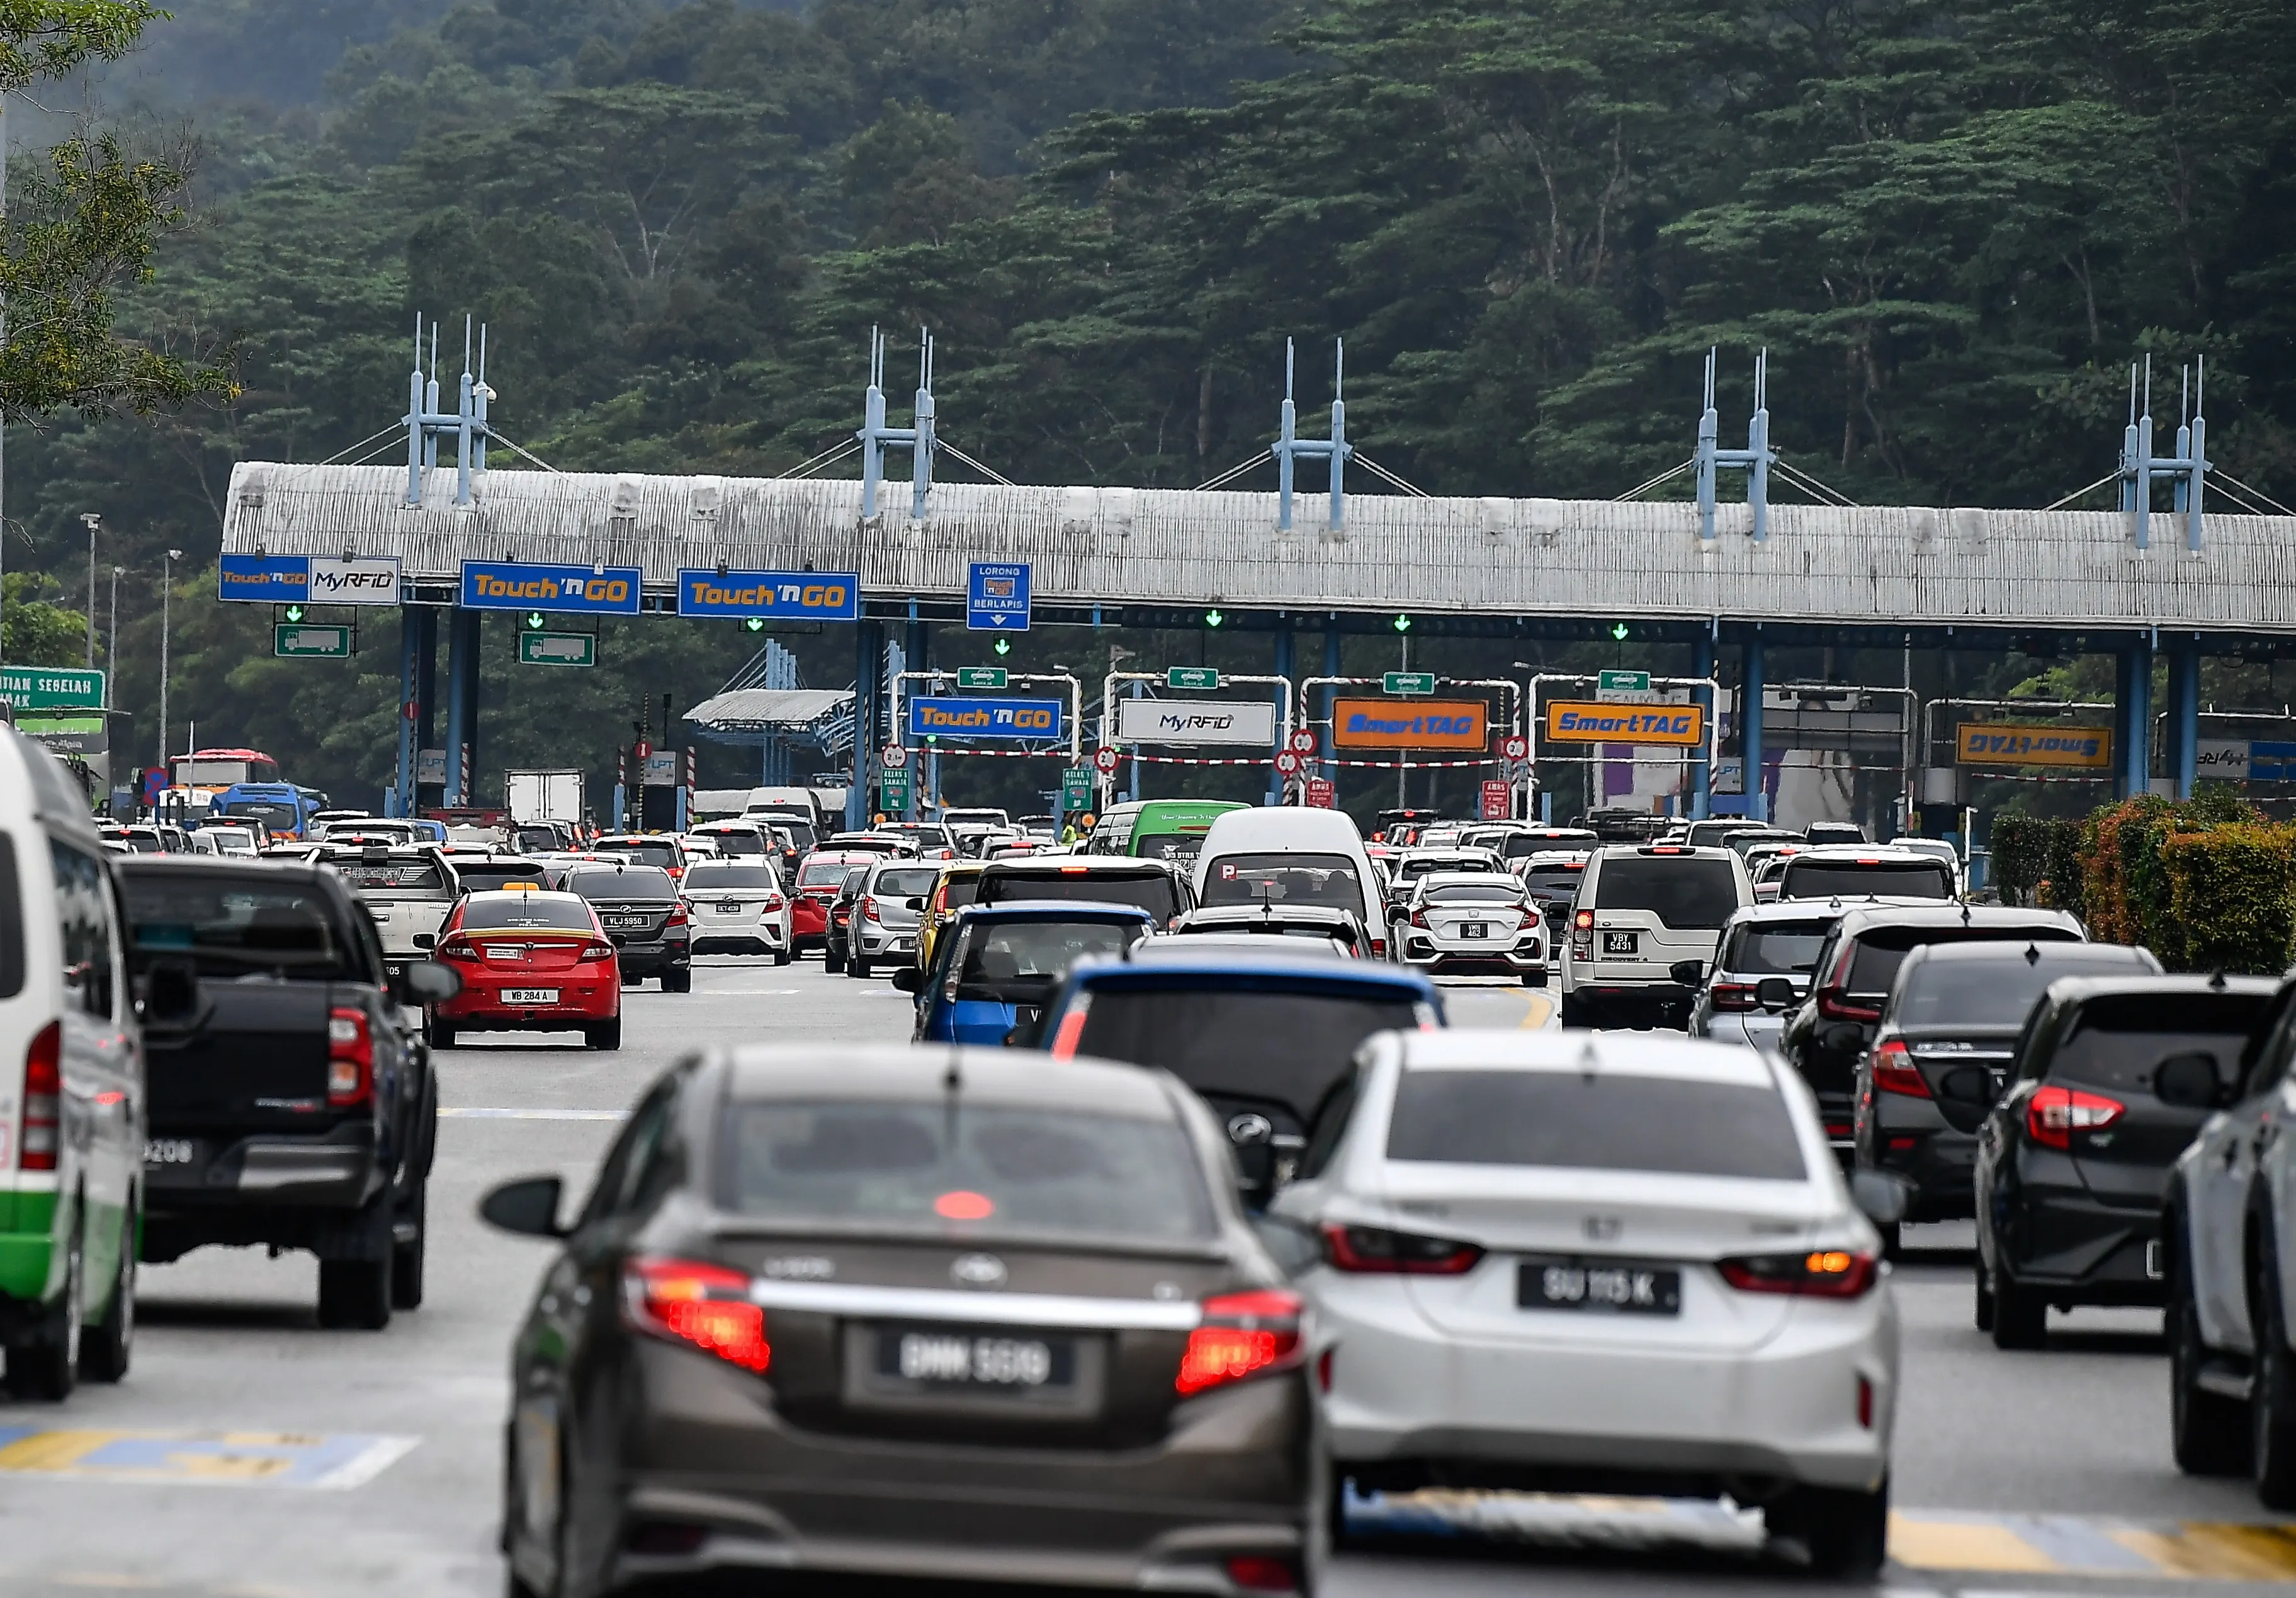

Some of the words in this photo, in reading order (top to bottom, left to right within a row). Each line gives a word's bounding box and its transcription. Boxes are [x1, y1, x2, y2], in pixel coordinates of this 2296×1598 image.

[475, 574, 558, 599] Touch
[585, 580, 628, 601] GO
[691, 582, 774, 605] Touch
[802, 585, 845, 607] GO
[974, 599, 1023, 609] BERLAPIS
[38, 678, 91, 694] SEBELAH
[920, 707, 990, 726] Touch
[1014, 709, 1051, 728] GO
[1558, 712, 1692, 733] SmartTAG
[1223, 865, 1235, 879] P
[1612, 933, 1629, 942] VBY
[1610, 942, 1631, 950] 5431
[511, 992, 522, 1000] WB
[524, 991, 540, 1000] 284
[542, 991, 548, 1000] A
